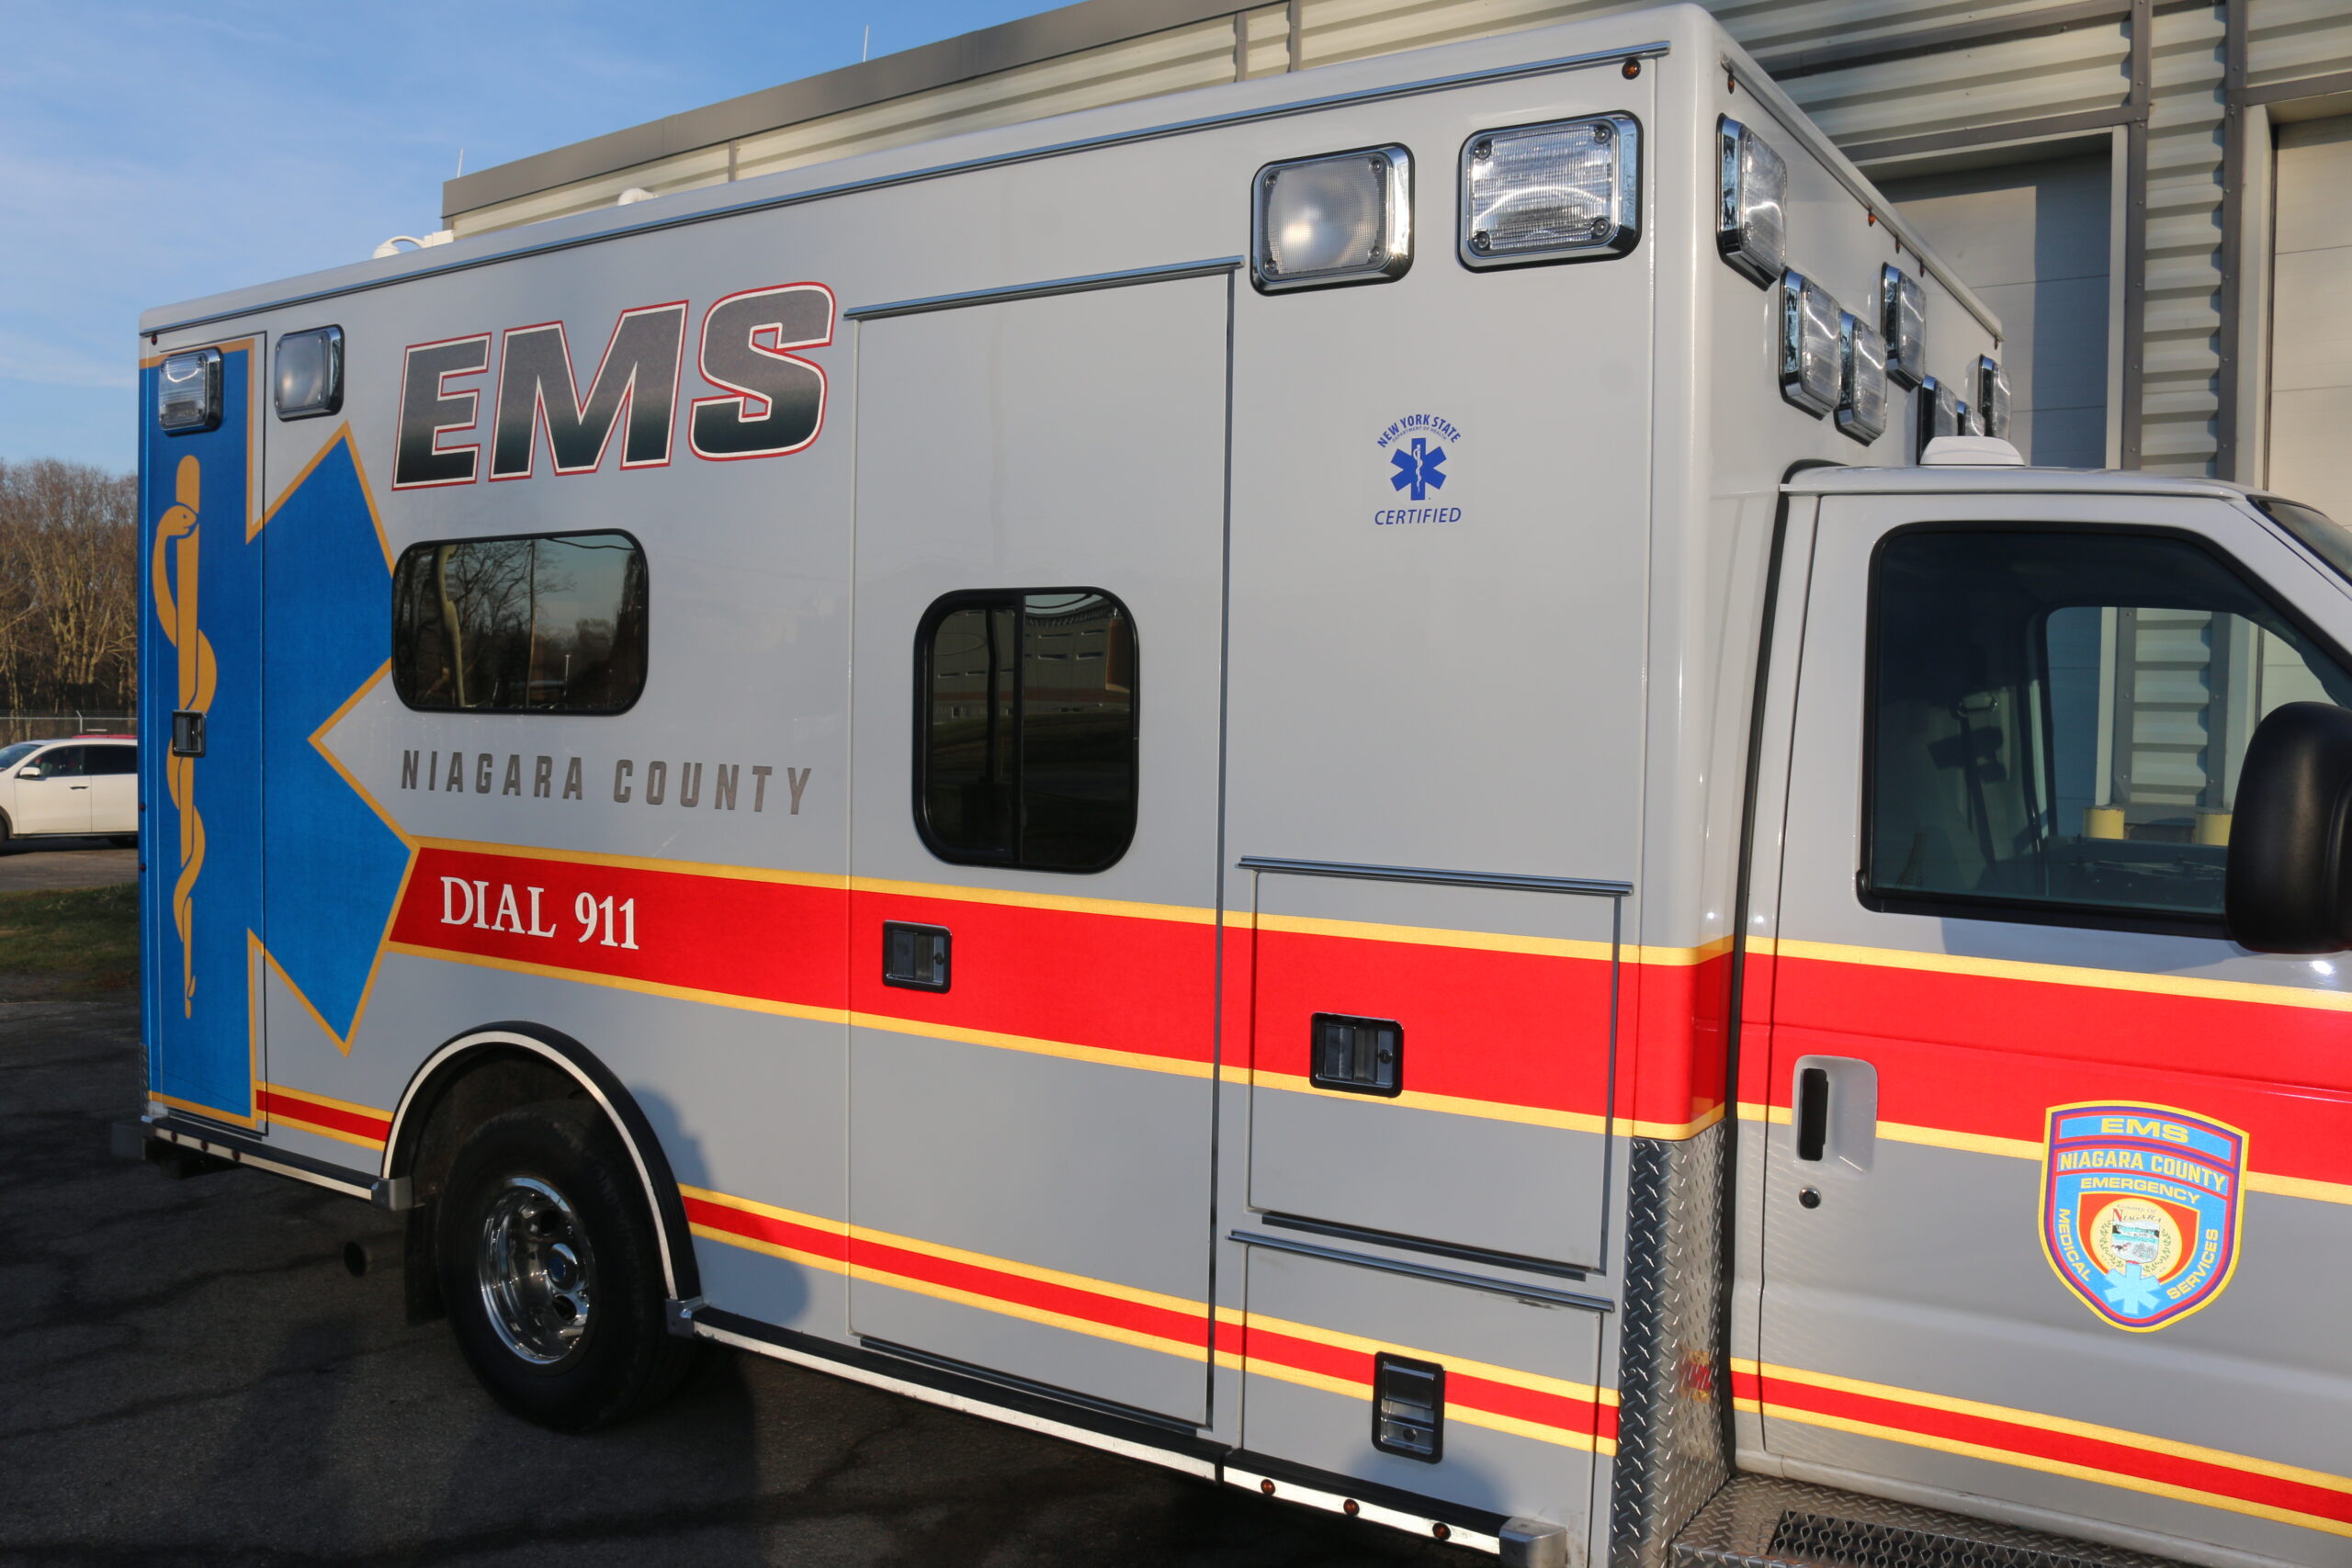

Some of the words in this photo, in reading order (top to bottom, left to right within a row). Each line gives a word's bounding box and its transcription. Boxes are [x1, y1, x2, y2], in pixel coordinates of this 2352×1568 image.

[391, 281, 836, 491] EMS
[1377, 423, 1399, 447] NEW
[1399, 413, 1430, 429] YORK
[1431, 416, 1461, 443] STATE
[1392, 425, 1421, 443] DEPARTMENT
[1430, 427, 1447, 441] HEALTH
[1374, 507, 1462, 525] CERTIFIED
[401, 750, 582, 800] NIAGARA
[613, 759, 811, 815] COUNTY
[440, 876, 556, 938] DIAL
[574, 892, 639, 950] 911
[2100, 1117, 2188, 1143] EMS
[2060, 1150, 2143, 1170] NIAGARA
[2151, 1156, 2226, 1191] COUNTY
[2080, 1177, 2200, 1204] EMERGENCY
[2058, 1208, 2092, 1281] MEDICAL
[2165, 1228, 2219, 1300] SERVICES
